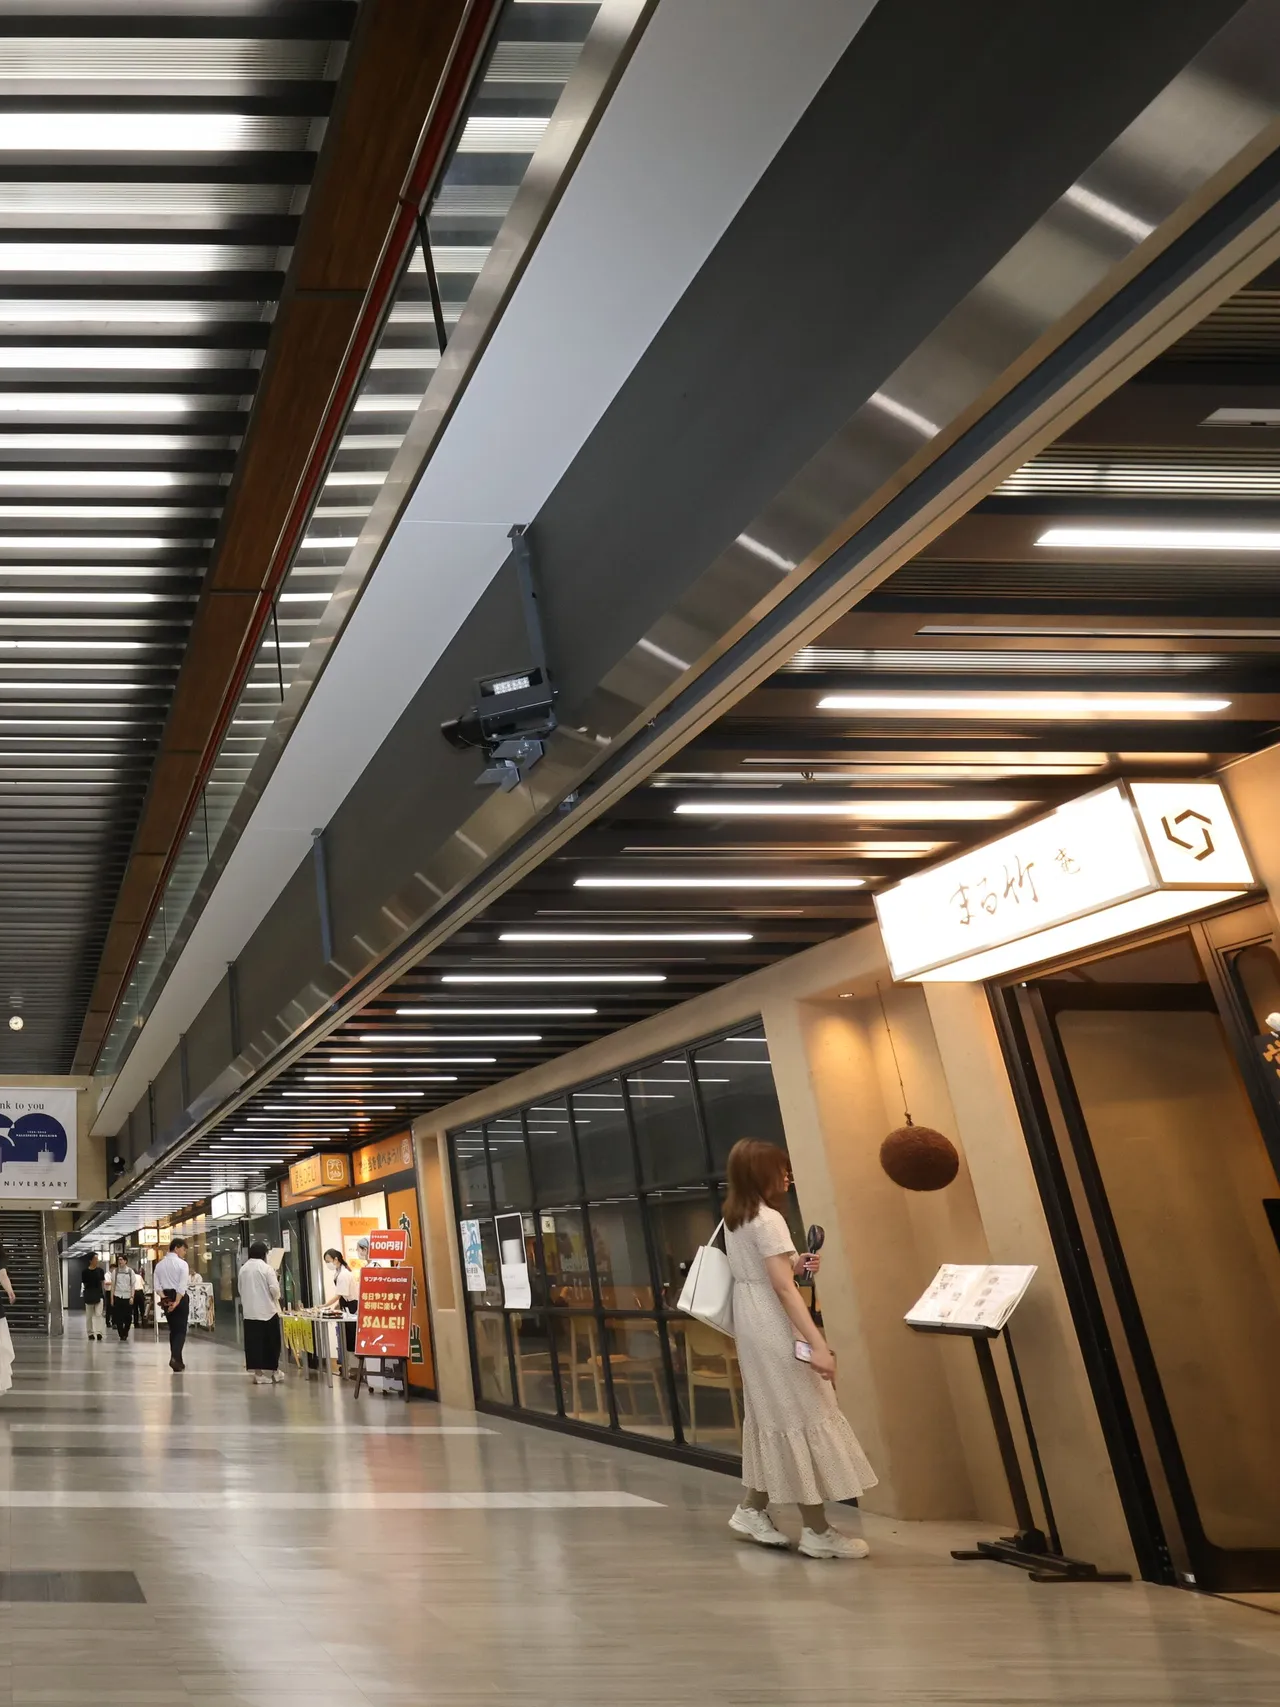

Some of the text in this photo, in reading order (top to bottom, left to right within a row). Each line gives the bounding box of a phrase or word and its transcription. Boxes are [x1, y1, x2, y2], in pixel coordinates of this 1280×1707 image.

[15, 1102, 25, 1110] to
[28, 1103, 45, 1111] you
[370, 1241, 404, 1251] 100円引
